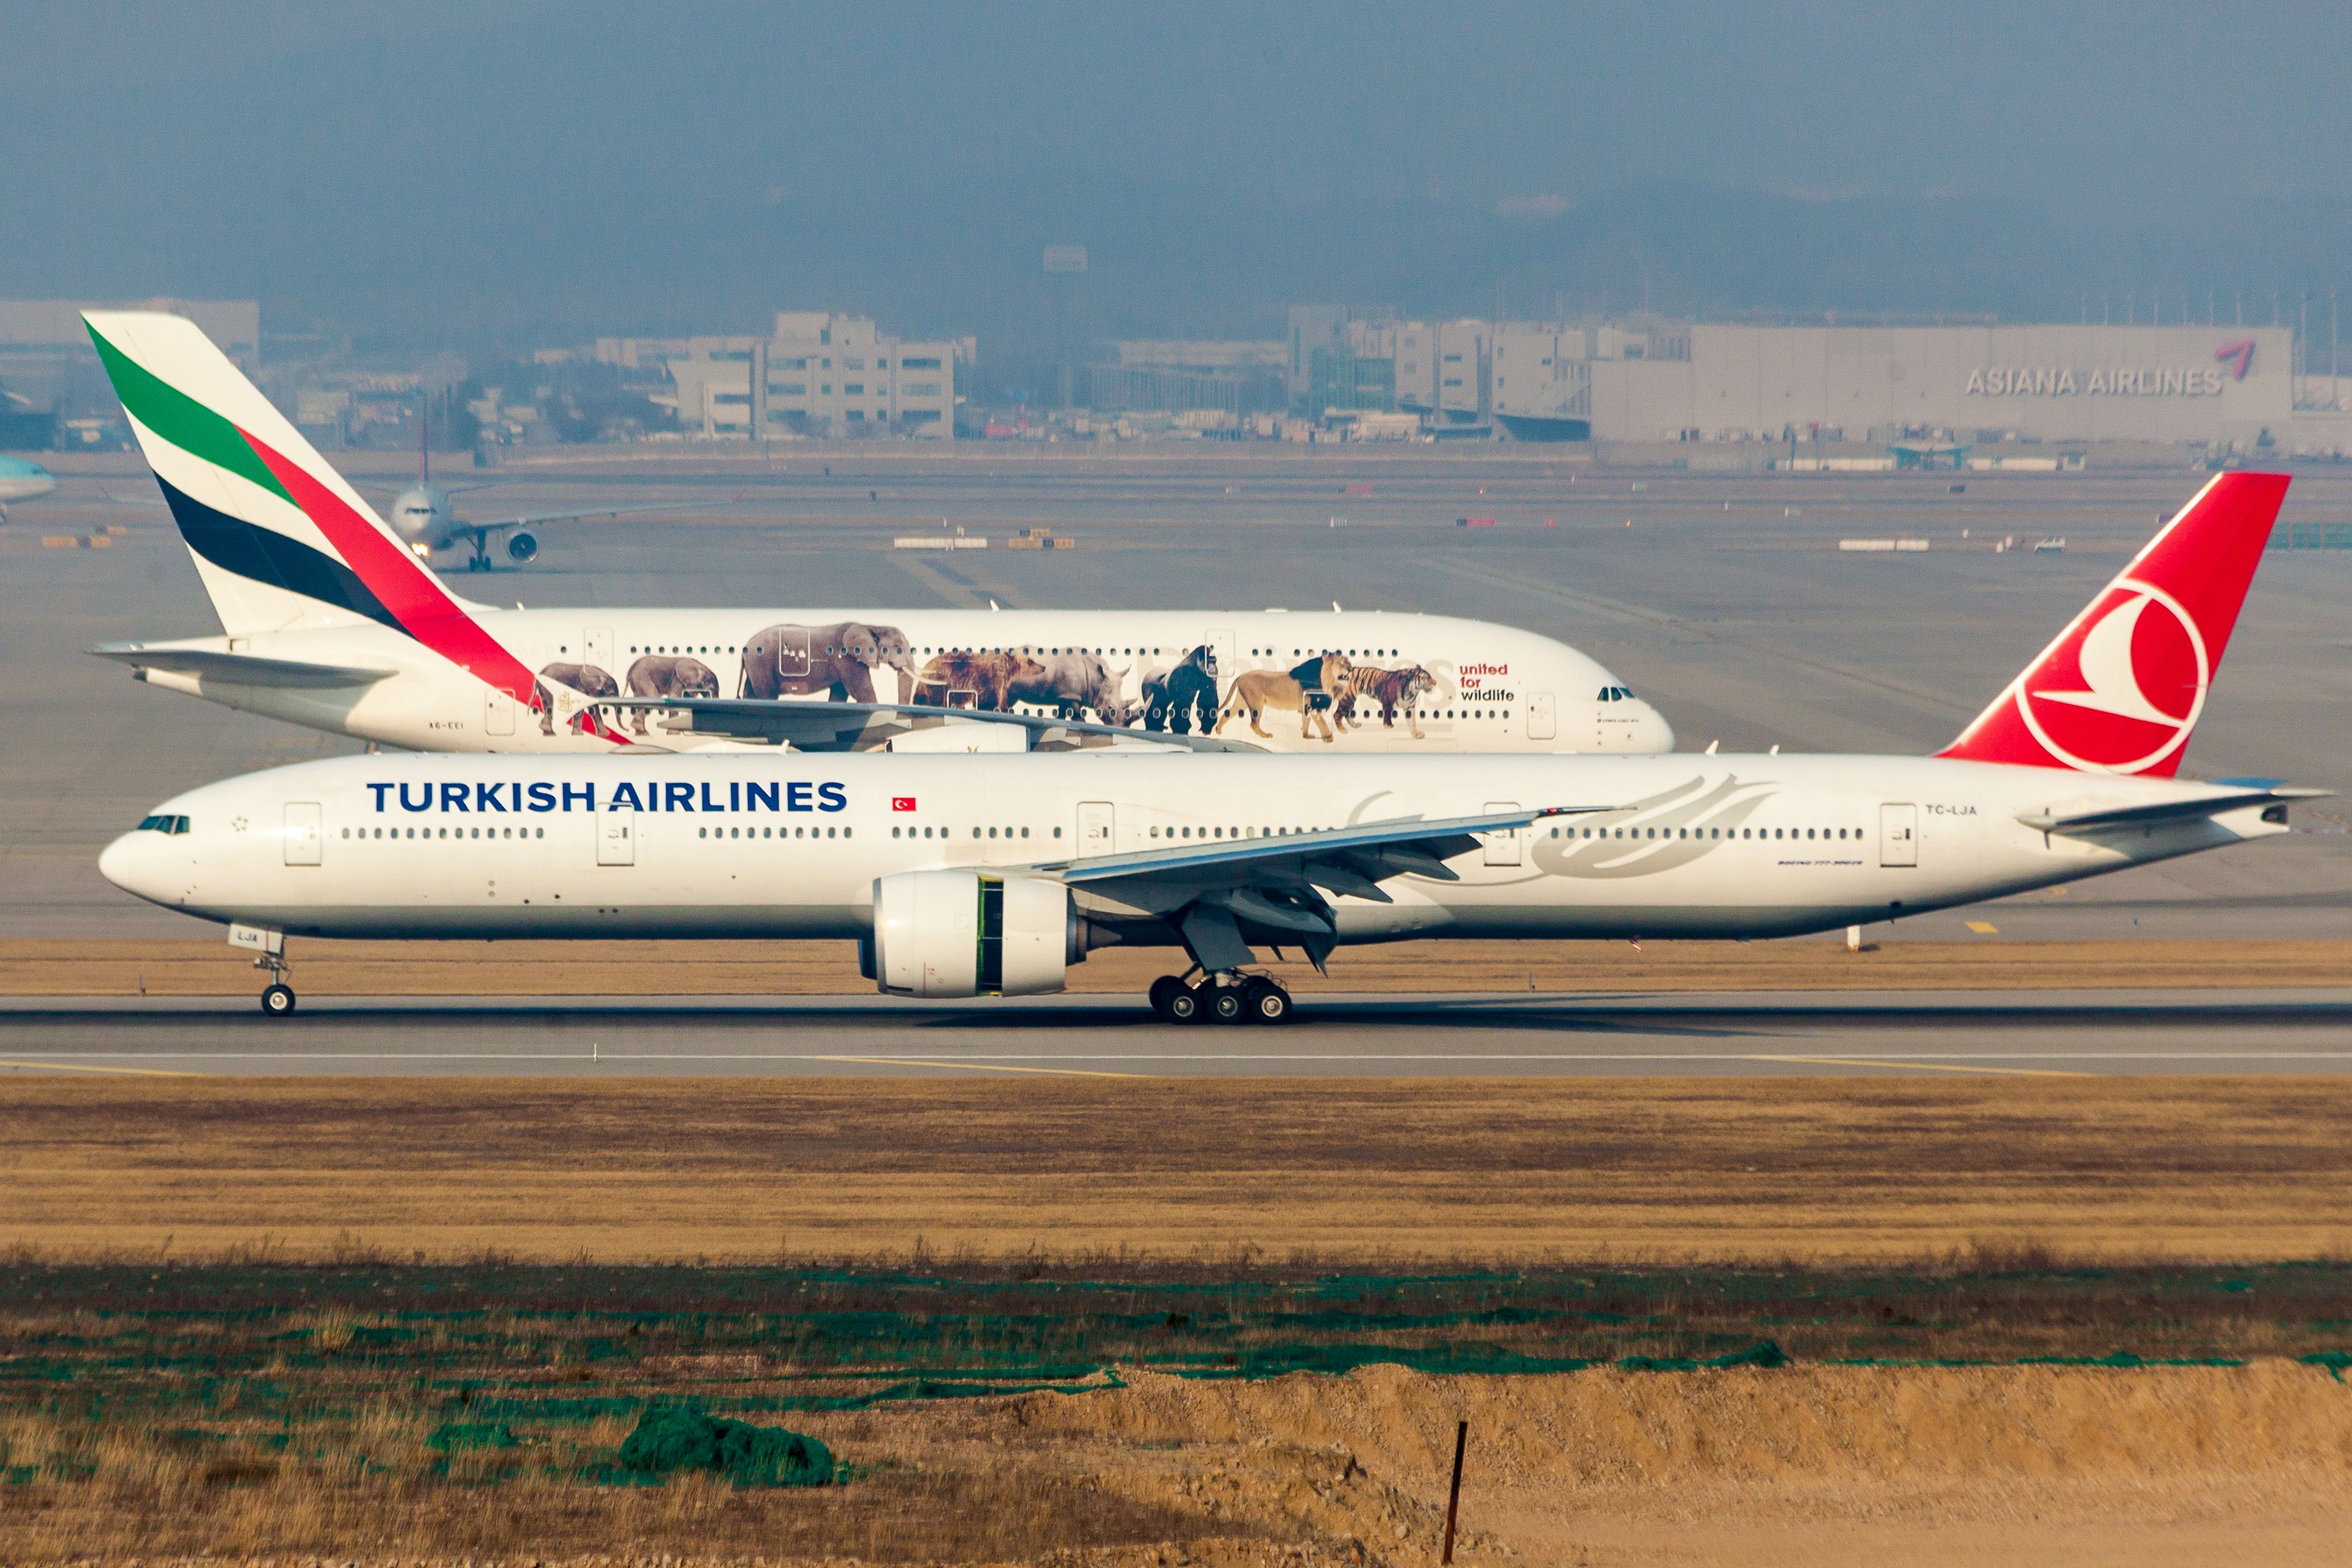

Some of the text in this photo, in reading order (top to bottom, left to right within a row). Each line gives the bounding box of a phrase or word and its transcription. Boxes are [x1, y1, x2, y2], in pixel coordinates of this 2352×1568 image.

[1966, 368, 2222, 395] ASIANA AIRLINES
[1459, 664, 1508, 675] united
[1461, 676, 1481, 688] for
[1461, 690, 1514, 701] wildlife
[366, 782, 847, 812] TURKISH AIRLINES
[1925, 804, 1977, 816] TC-LJA
[238, 931, 257, 943] LJA
